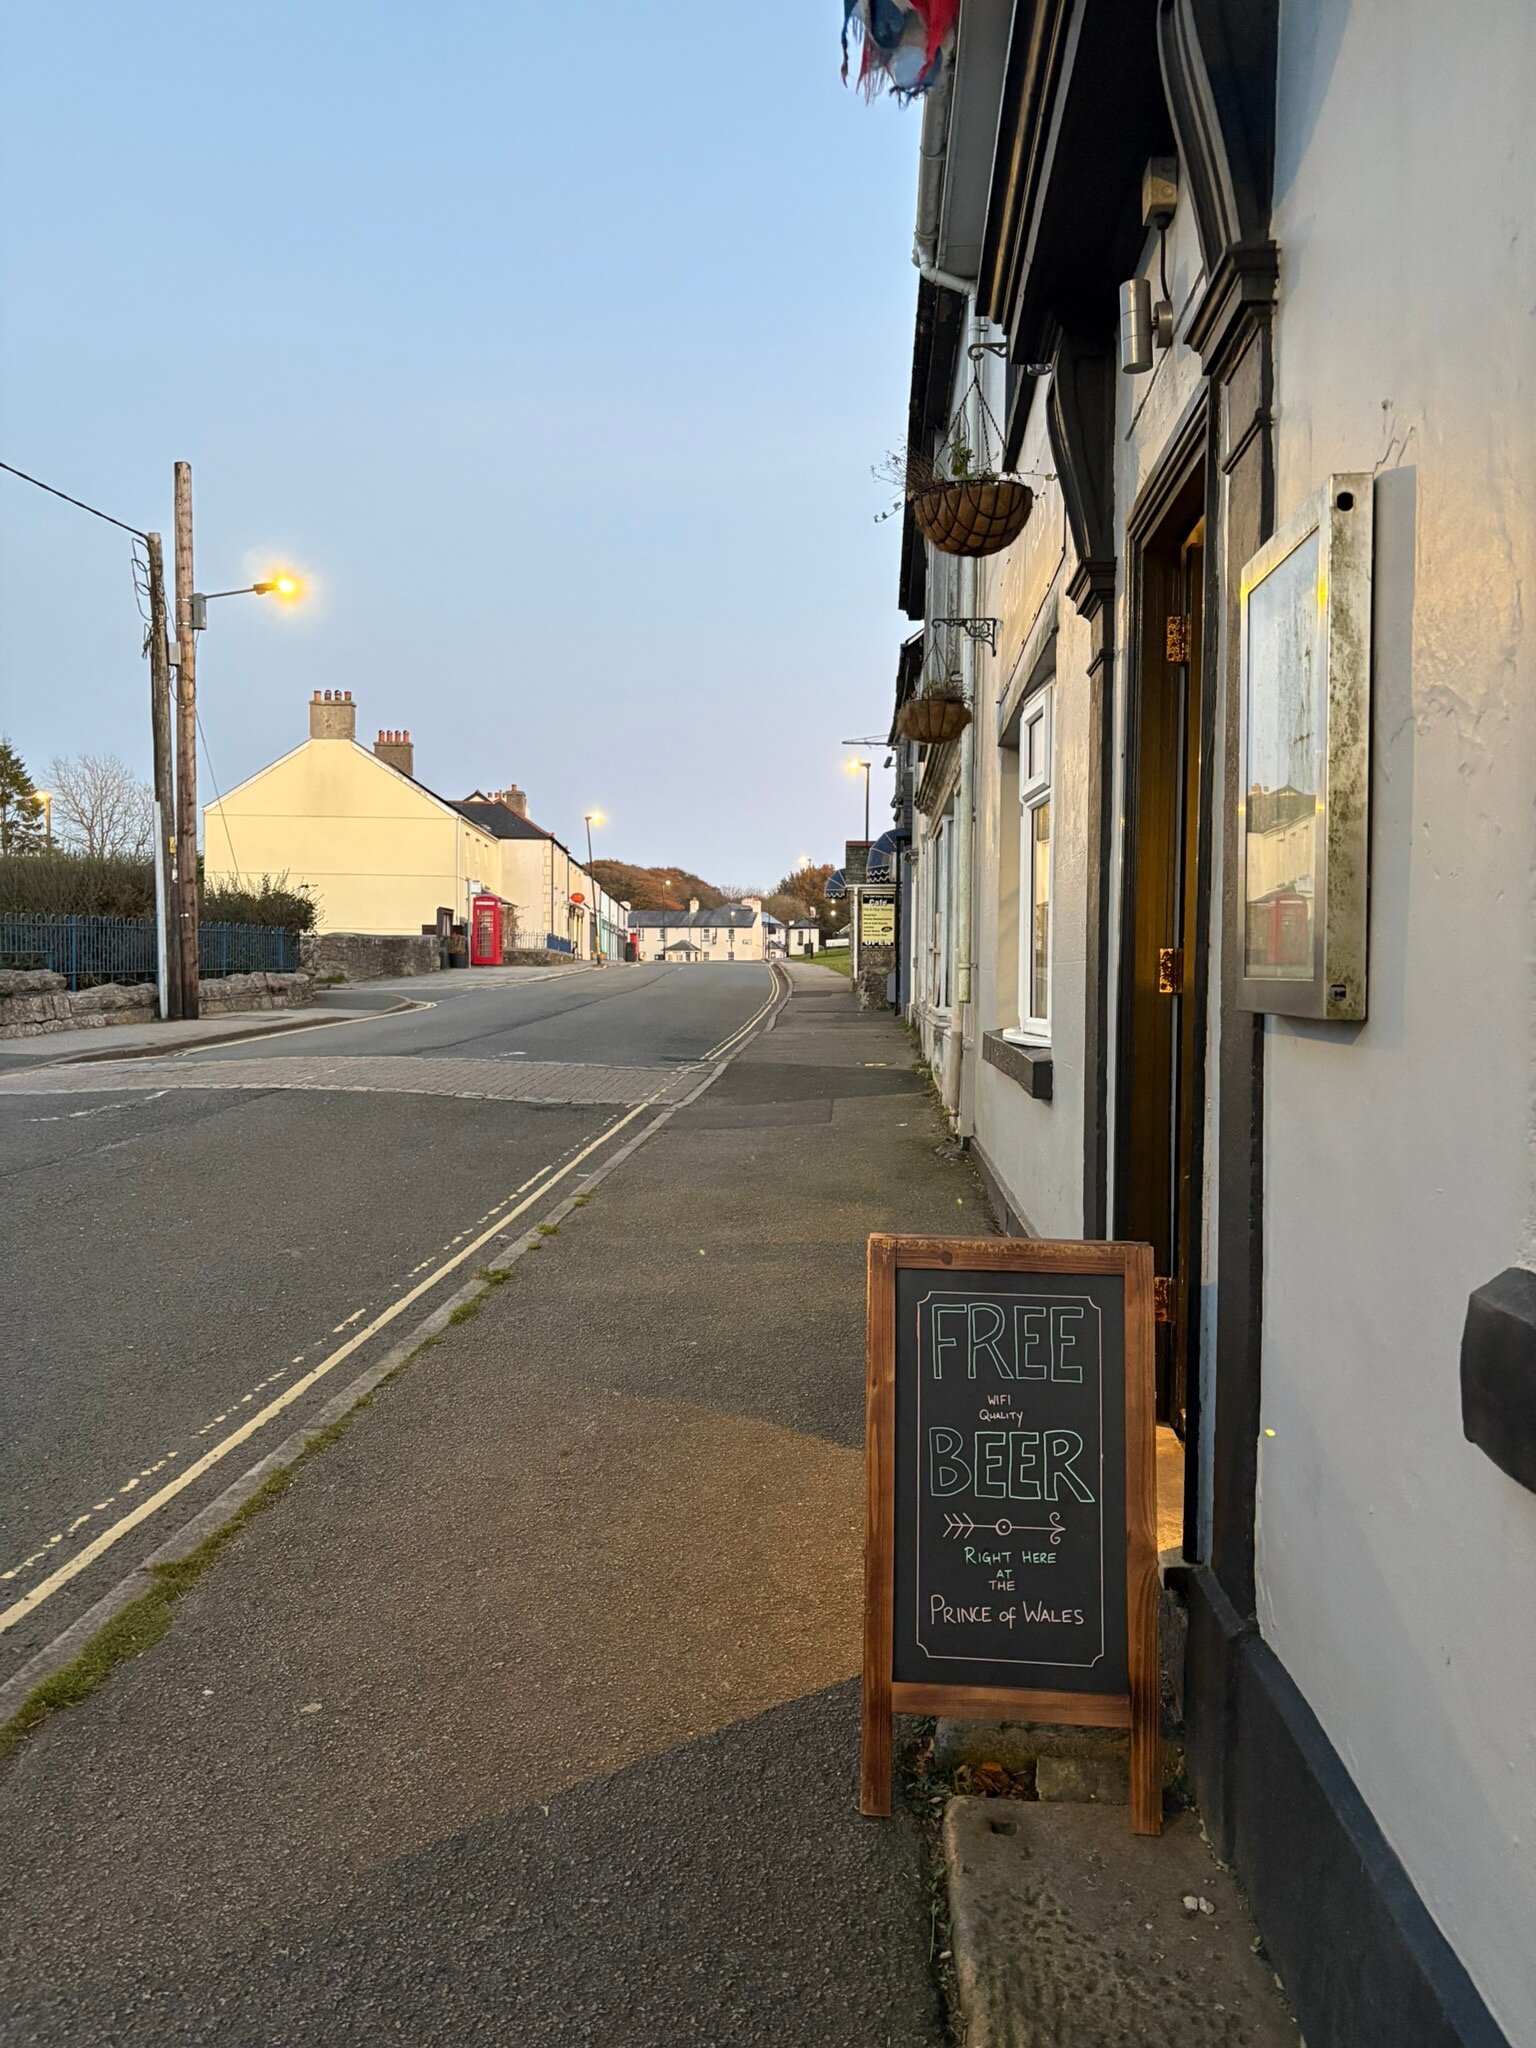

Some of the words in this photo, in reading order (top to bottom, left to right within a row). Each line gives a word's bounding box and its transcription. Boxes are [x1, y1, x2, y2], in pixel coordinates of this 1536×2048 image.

[931, 1302, 1084, 1383] FREE
[987, 1394, 1011, 1406] WIFI
[929, 1426, 1096, 1503] BEER
[964, 1546, 1012, 1565] RIGHT
[1021, 1551, 1057, 1564] HERE
[996, 1569, 1013, 1579] AT
[988, 1580, 1016, 1592] THE
[930, 1594, 992, 1625] PRINCE
[999, 1607, 1017, 1630] of
[1022, 1600, 1085, 1625] WALES
